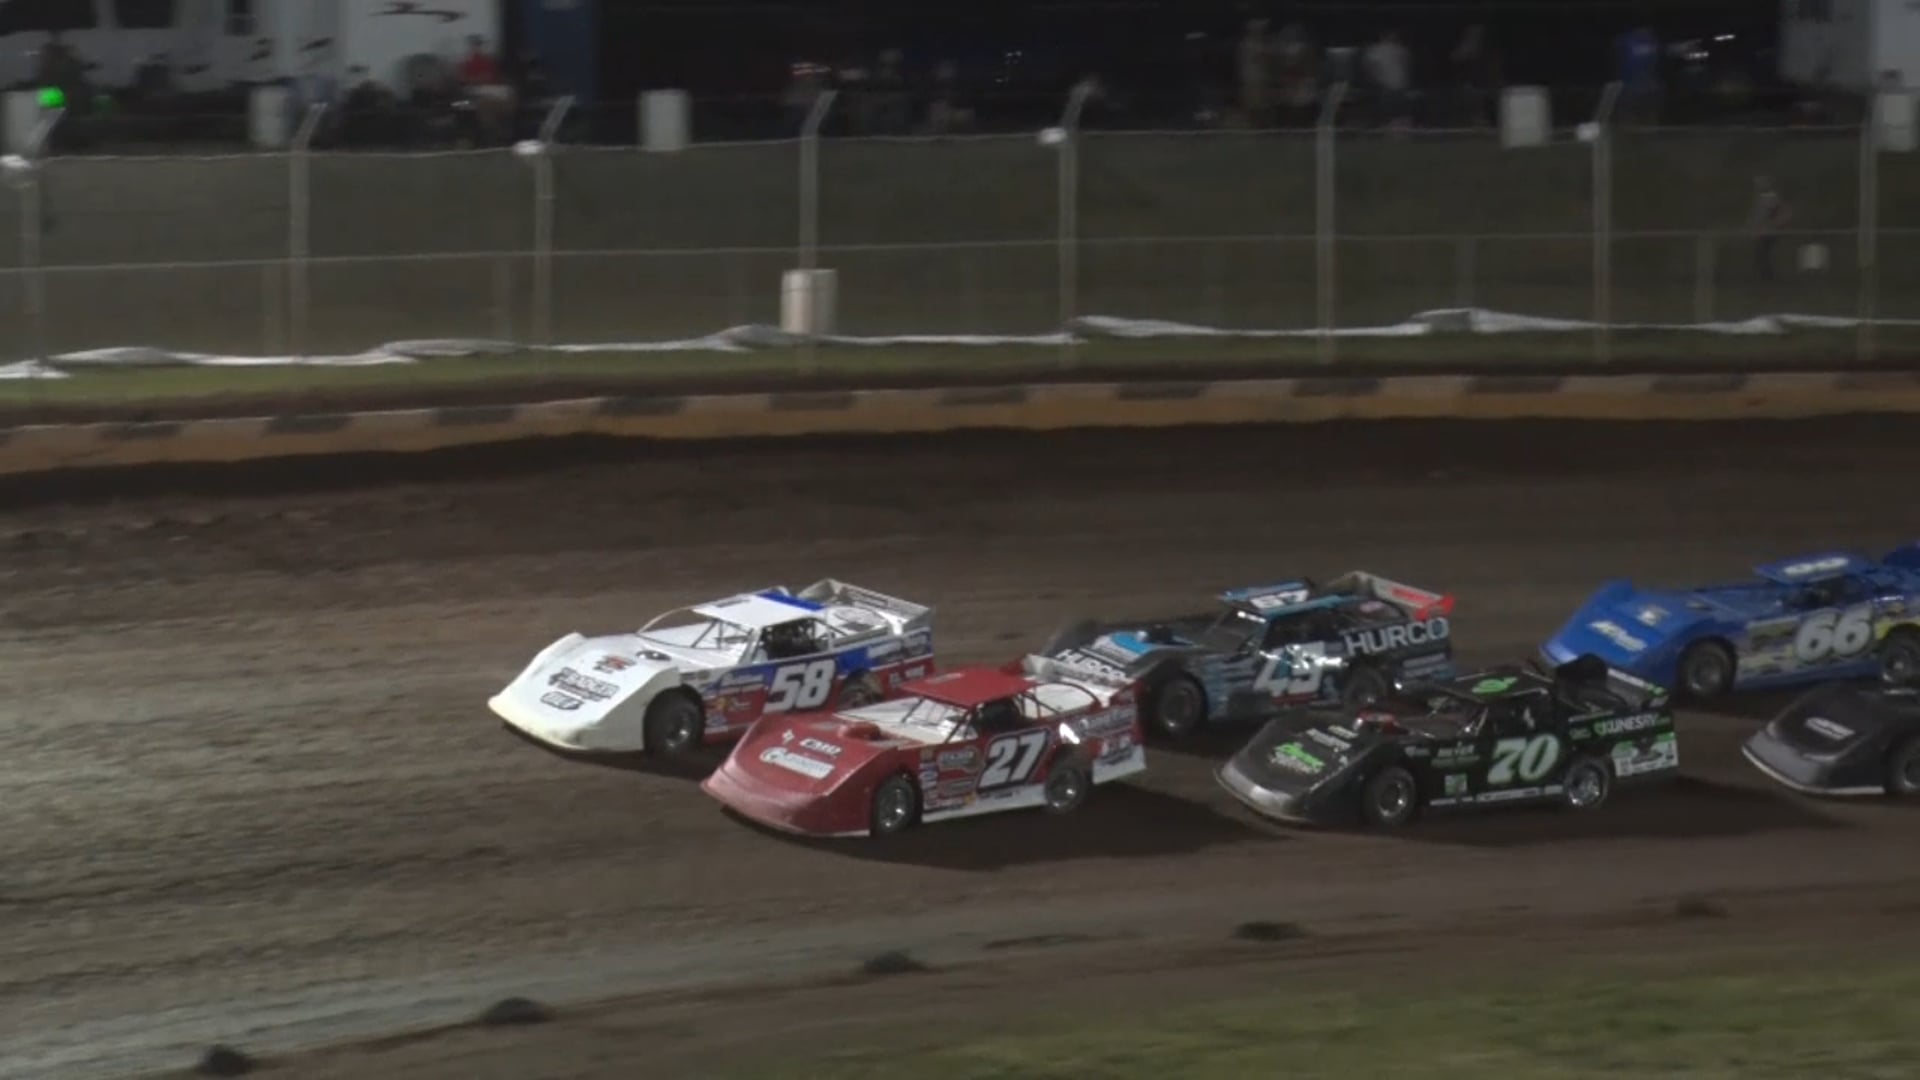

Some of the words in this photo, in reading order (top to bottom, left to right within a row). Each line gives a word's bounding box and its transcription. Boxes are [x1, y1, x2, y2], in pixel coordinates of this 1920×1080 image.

[1344, 617, 1450, 657] HURCO
[1797, 601, 1871, 661] 66
[763, 659, 836, 714] 58
[979, 731, 1047, 788] 27
[1487, 734, 1559, 784] 70
